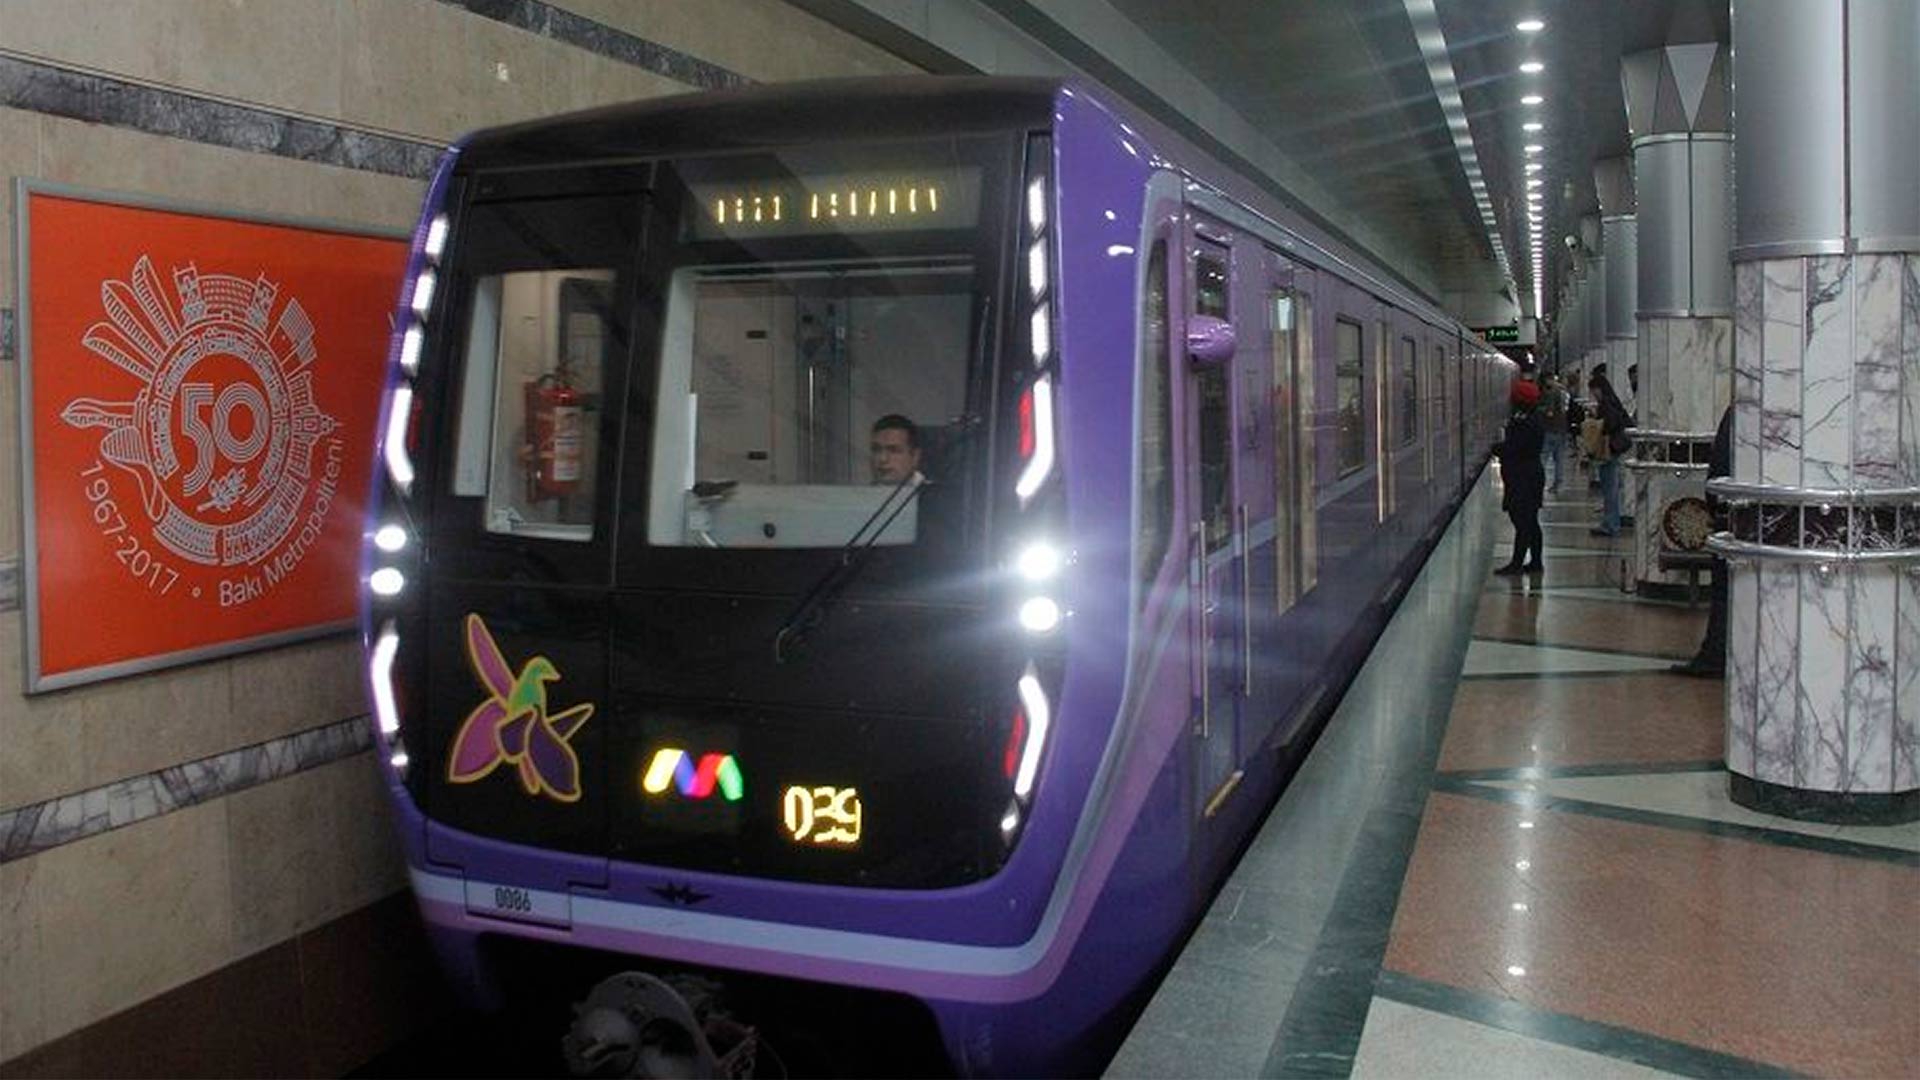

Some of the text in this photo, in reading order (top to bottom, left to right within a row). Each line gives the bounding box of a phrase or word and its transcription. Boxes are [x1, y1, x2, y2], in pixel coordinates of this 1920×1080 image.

[181, 382, 271, 498] 50
[81, 459, 180, 595] 1967-2017
[264, 438, 343, 586] Metropoliteni
